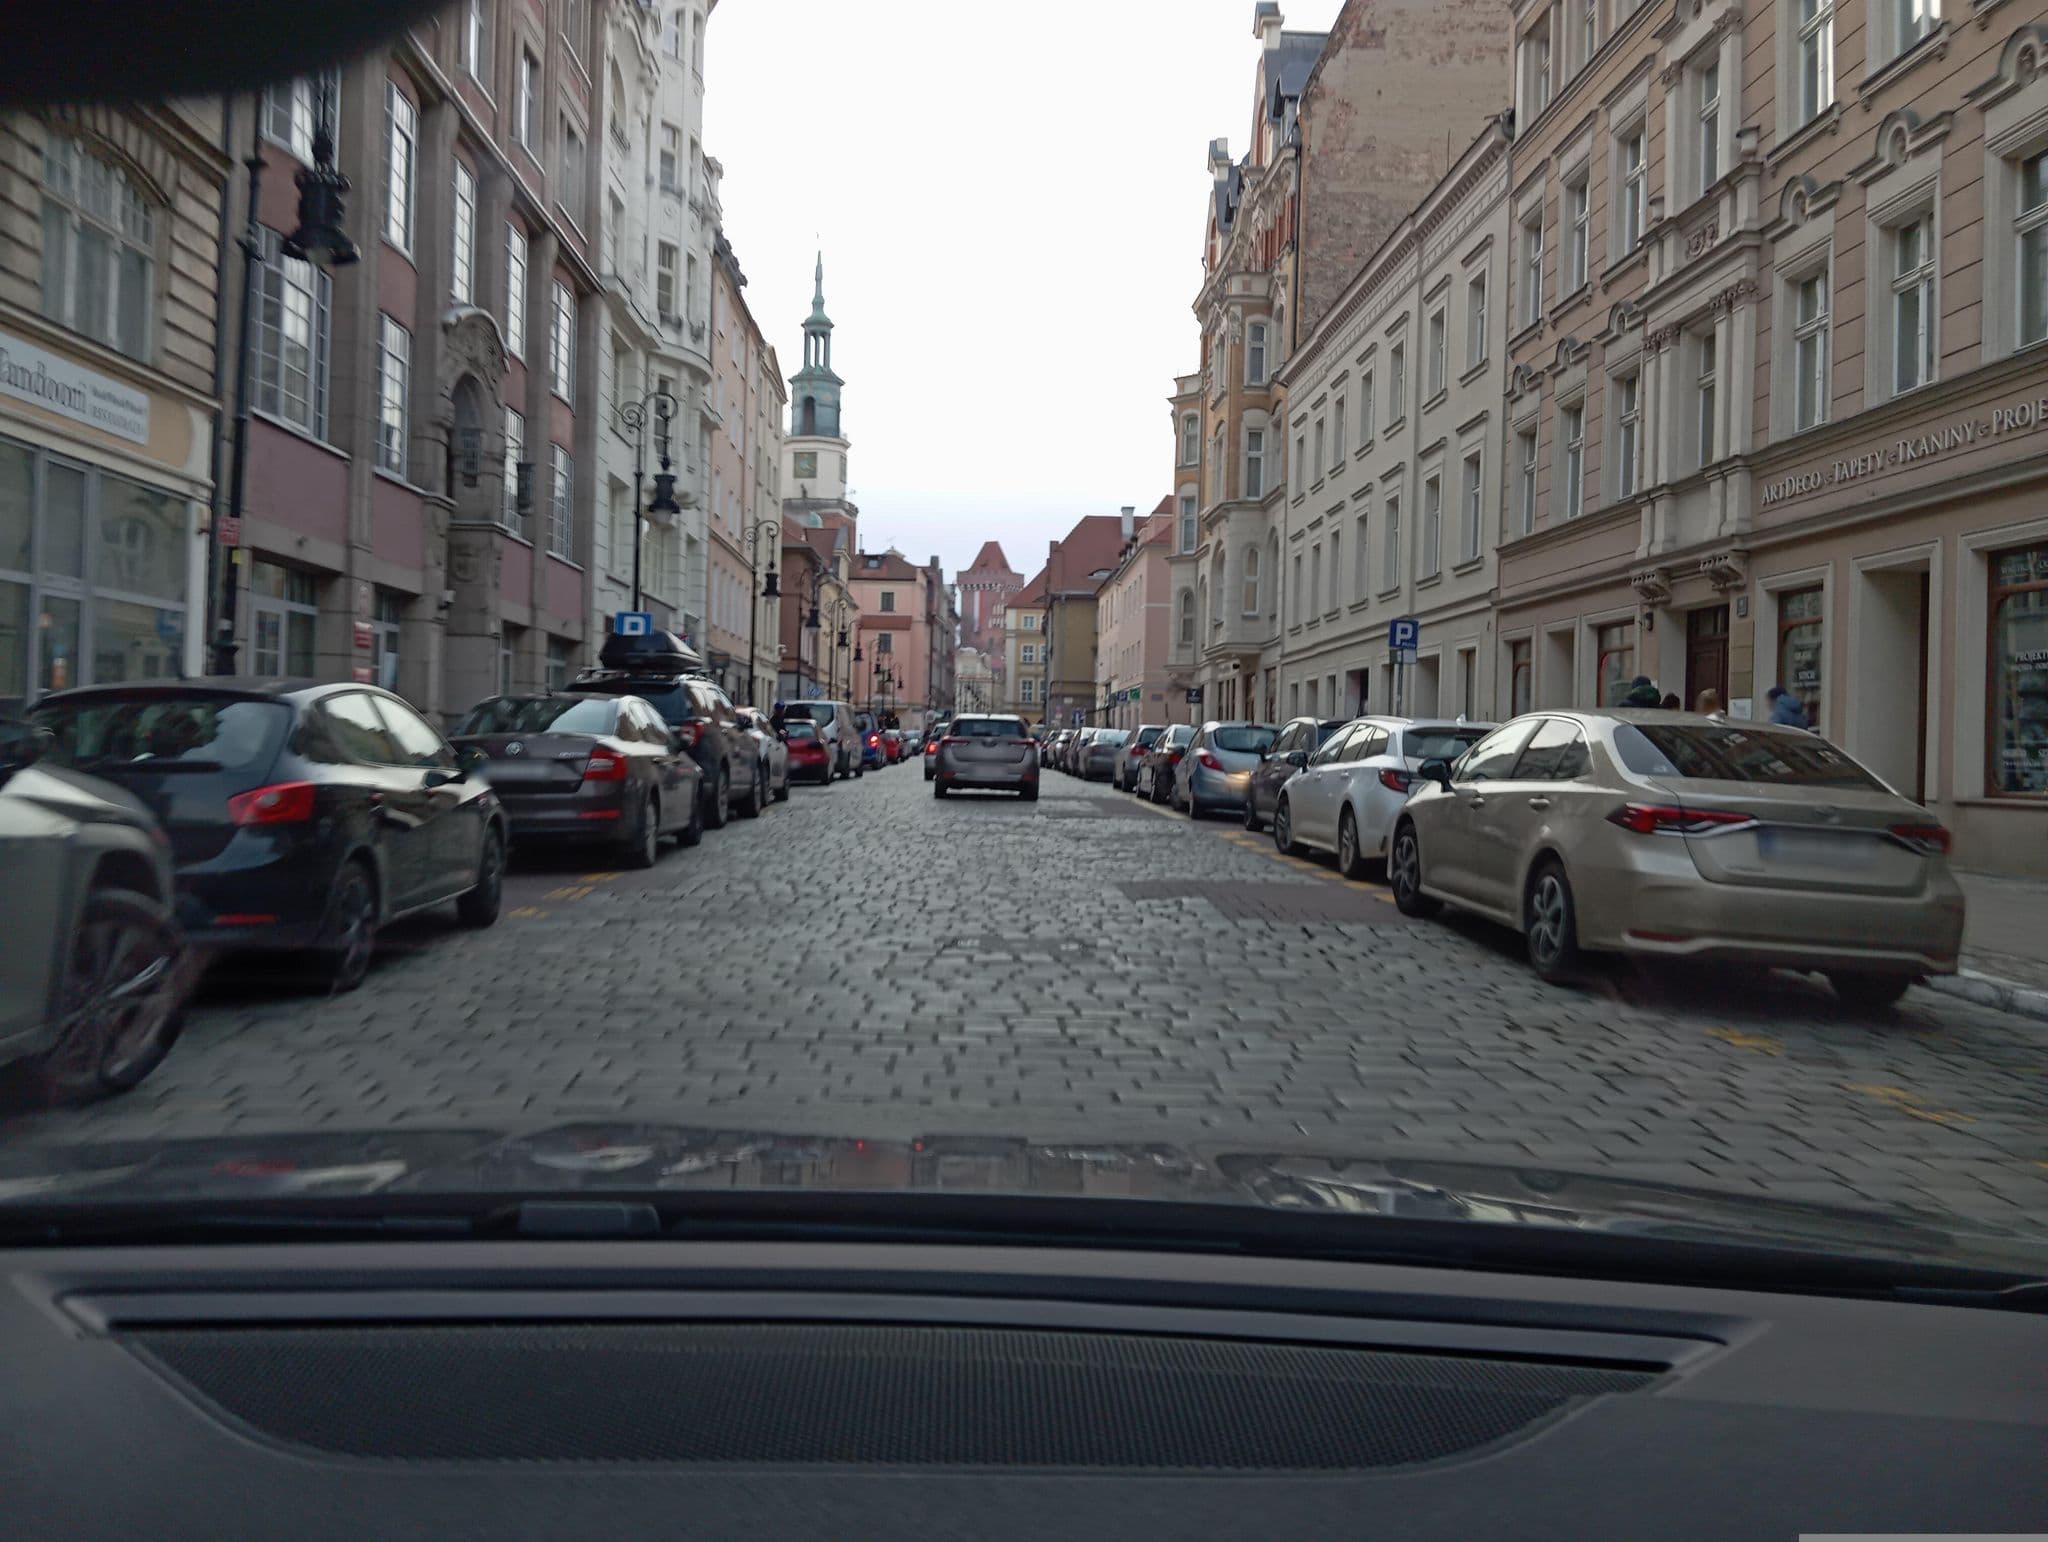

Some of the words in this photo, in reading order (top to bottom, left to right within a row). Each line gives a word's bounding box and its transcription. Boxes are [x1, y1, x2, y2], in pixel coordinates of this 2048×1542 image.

[1832, 448, 1887, 482] TAPETY
[1896, 420, 1978, 464] TKANINY
[1395, 622, 1413, 645] P
